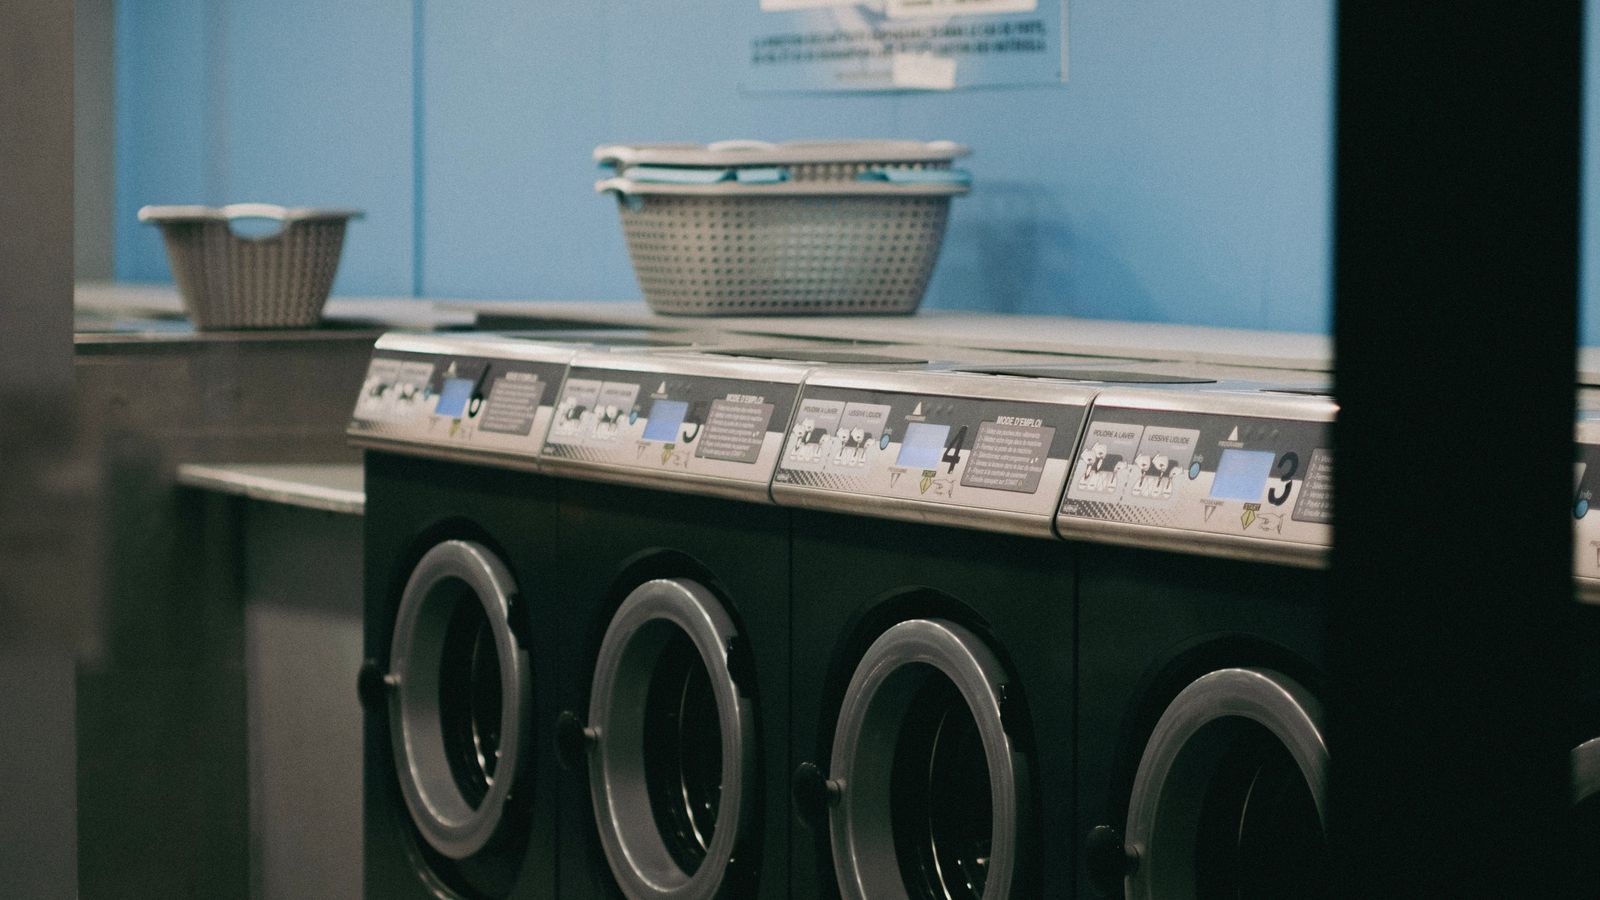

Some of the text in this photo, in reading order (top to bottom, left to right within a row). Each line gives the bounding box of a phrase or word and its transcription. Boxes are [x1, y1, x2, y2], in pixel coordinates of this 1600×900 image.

[468, 362, 491, 419] 6
[996, 415, 1043, 428] MODE D'EMPLOI
[1093, 429, 1114, 438] POUDRE
[1118, 432, 1136, 440] LAVER
[942, 424, 969, 475] 4
[1148, 433, 1191, 445] LESSIVE LIQUIDE
[1267, 451, 1299, 507] 3
